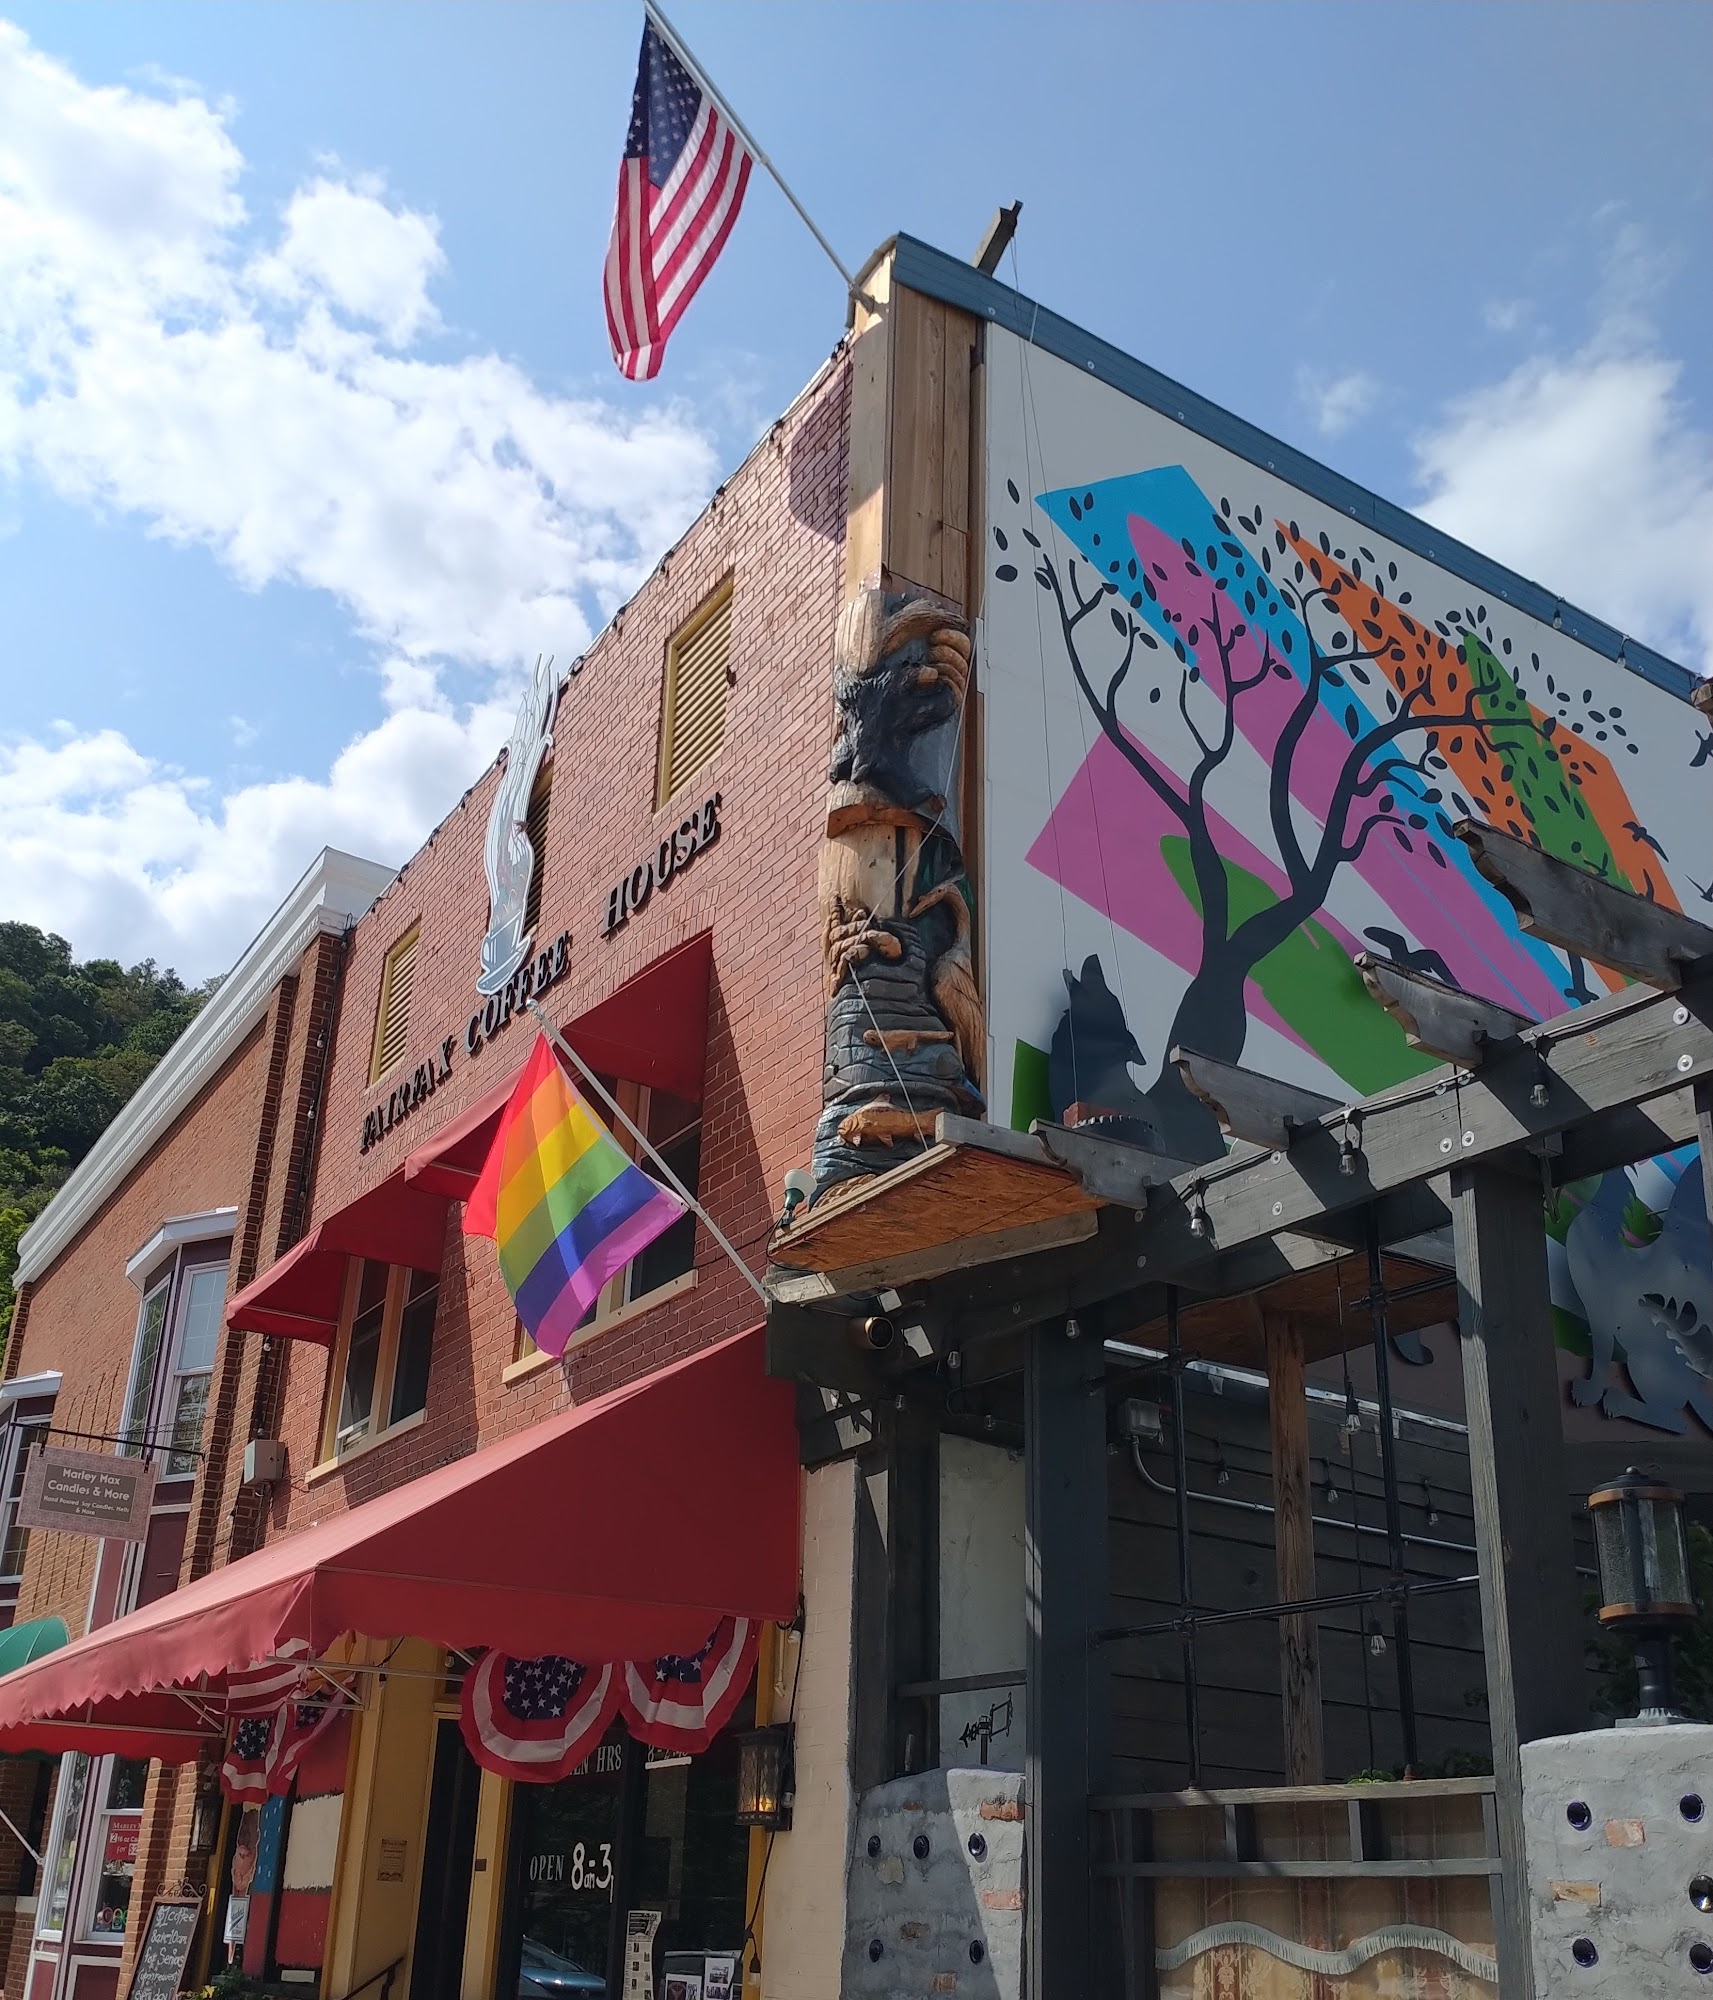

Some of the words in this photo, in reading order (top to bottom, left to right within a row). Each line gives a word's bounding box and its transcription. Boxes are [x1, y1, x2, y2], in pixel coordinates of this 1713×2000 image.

[360, 1034, 456, 1151] FAIRFAX
[464, 930, 573, 1053] COFFEE
[600, 792, 721, 938] HOUSE
[62, 1468, 97, 1484] Marley
[100, 1474, 121, 1485] Max
[43, 1495, 59, 1503] Hand
[47, 1480, 90, 1495] Candles
[92, 1486, 101, 1497] &
[104, 1488, 130, 1500] More
[596, 1744, 621, 1773] HRS
[530, 1855, 564, 1880] OPEN
